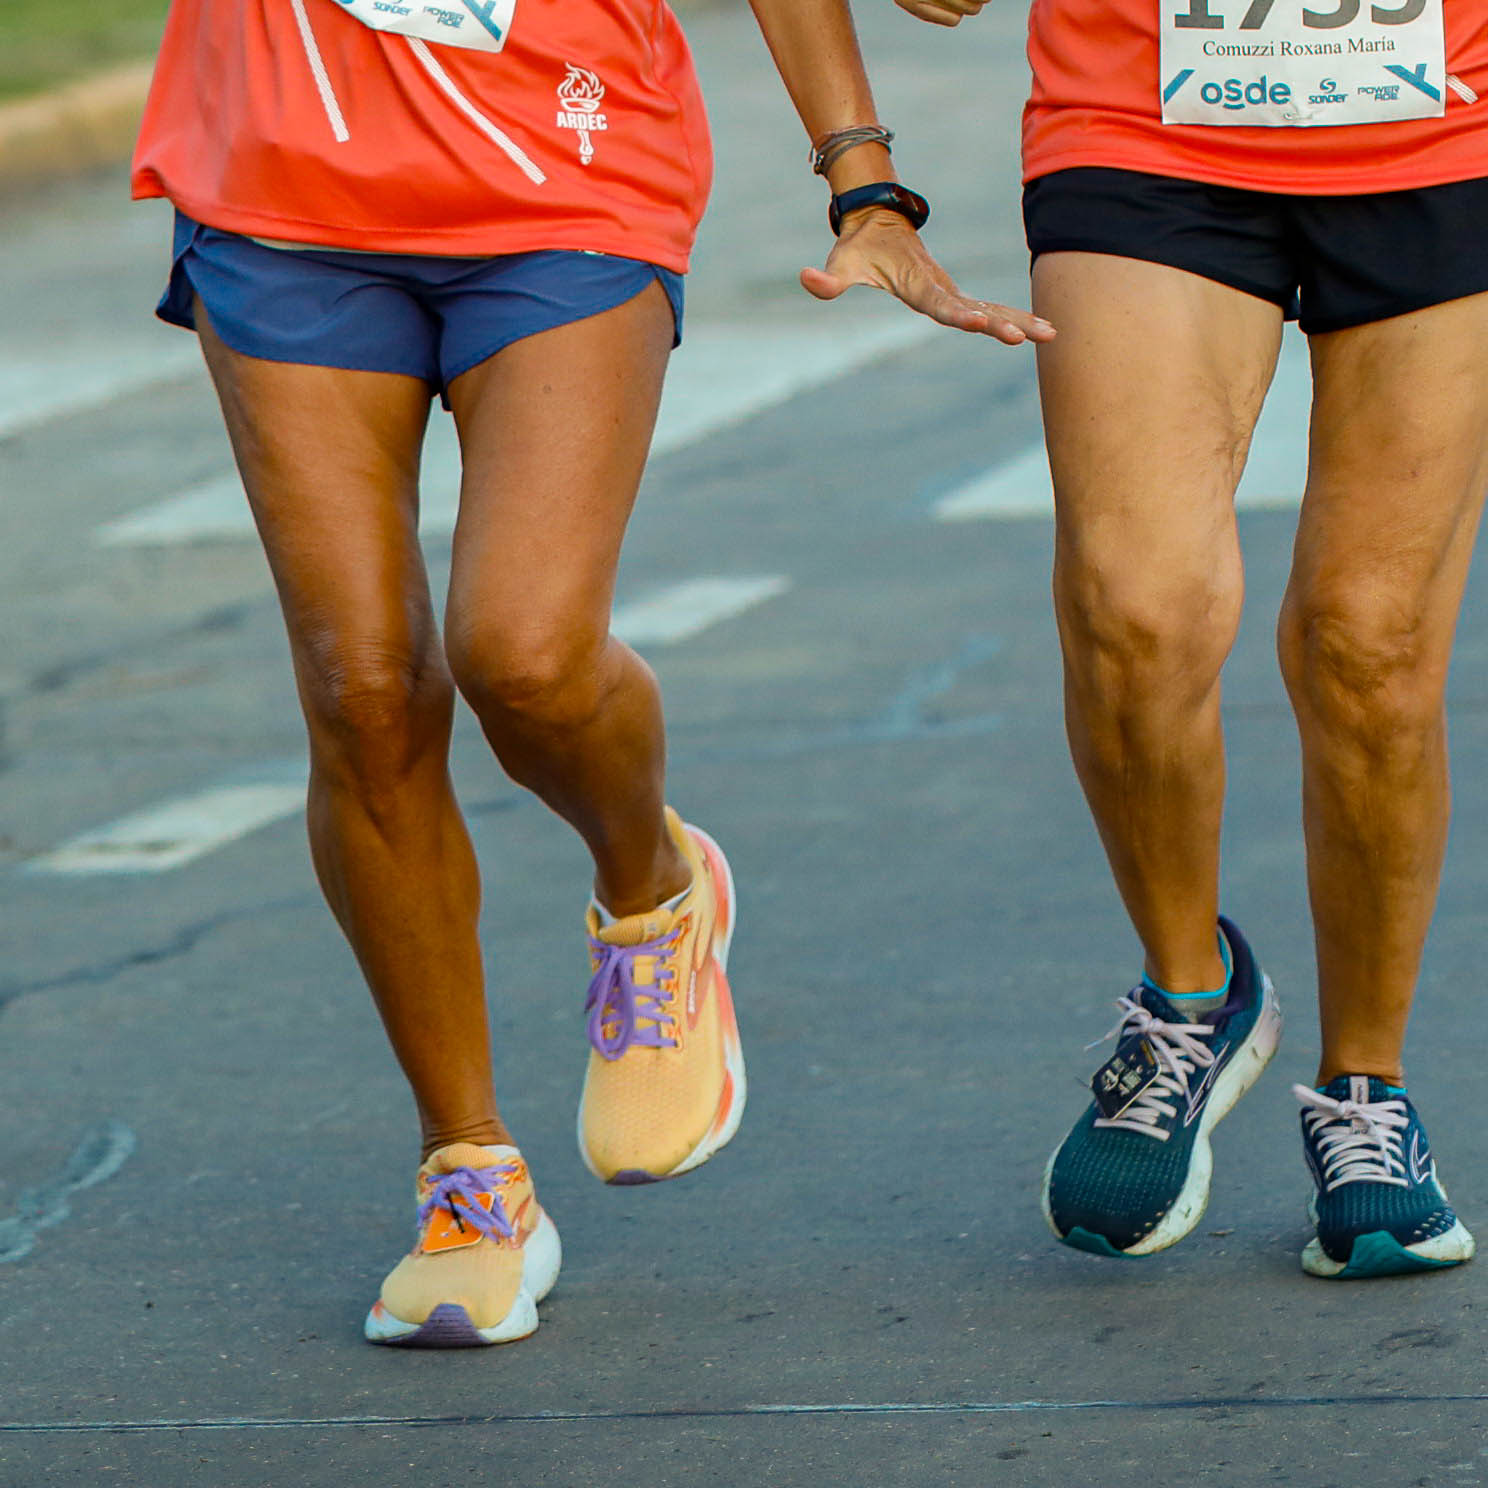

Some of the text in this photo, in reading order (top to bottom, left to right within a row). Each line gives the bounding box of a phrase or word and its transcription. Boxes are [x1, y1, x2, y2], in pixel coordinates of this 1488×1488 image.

[1202, 35, 1396, 57] Comuzzi Roxana María
[1200, 74, 1292, 110] osde
[557, 111, 609, 131] ARDEC
